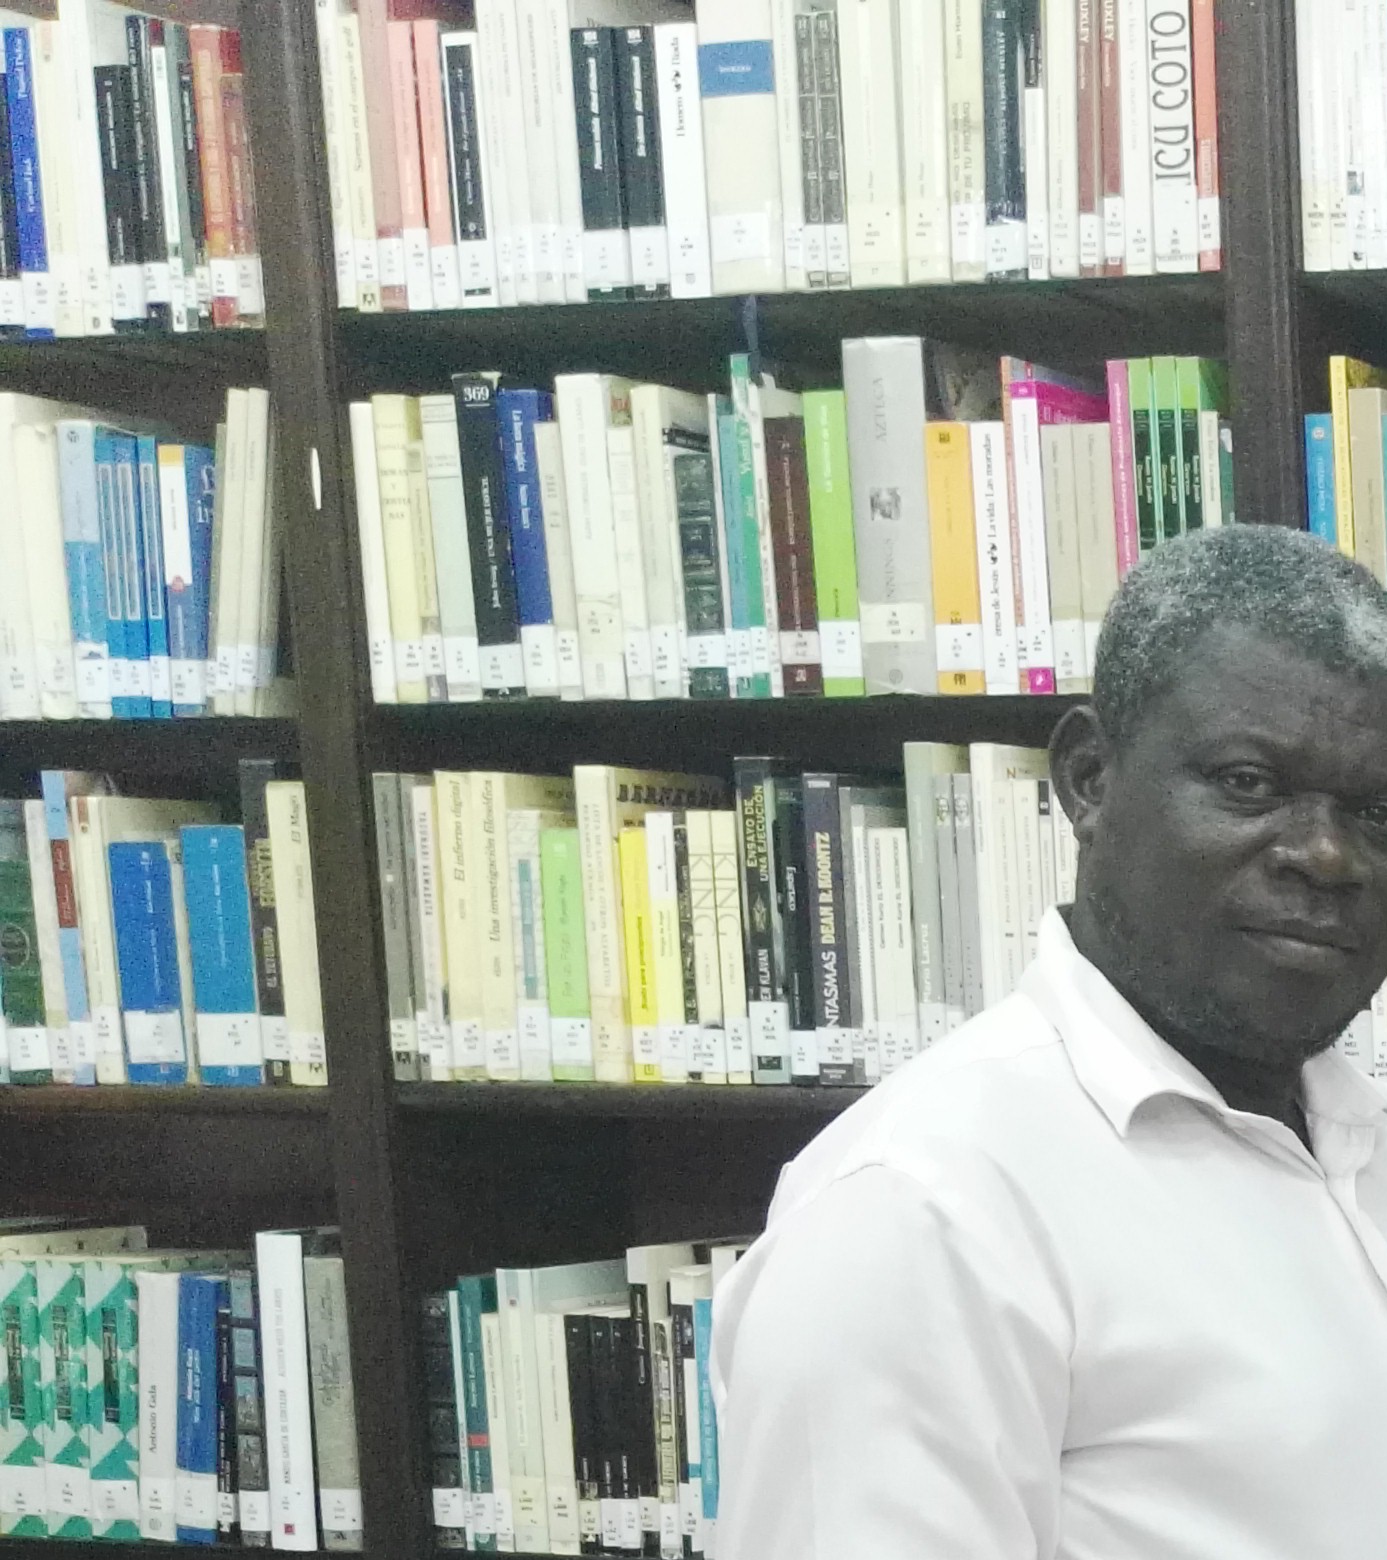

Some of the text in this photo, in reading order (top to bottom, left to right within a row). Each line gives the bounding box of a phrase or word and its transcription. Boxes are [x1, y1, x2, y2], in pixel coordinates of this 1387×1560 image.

[1150, 10, 1190, 111] COTO
[462, 384, 491, 404] 369
[873, 376, 889, 443] AZTECA
[448, 780, 465, 882] El infierno digital
[744, 799, 759, 868] ENSAYO DE
[751, 785, 769, 881] UNA EJECUCIÓN
[816, 831, 833, 889] KOONTZ
[691, 851, 714, 937] KING
[718, 851, 738, 937] KING
[819, 905, 836, 944] DEAN
[821, 951, 840, 1024] NTASMAS
[147, 1384, 157, 1408] Gala
